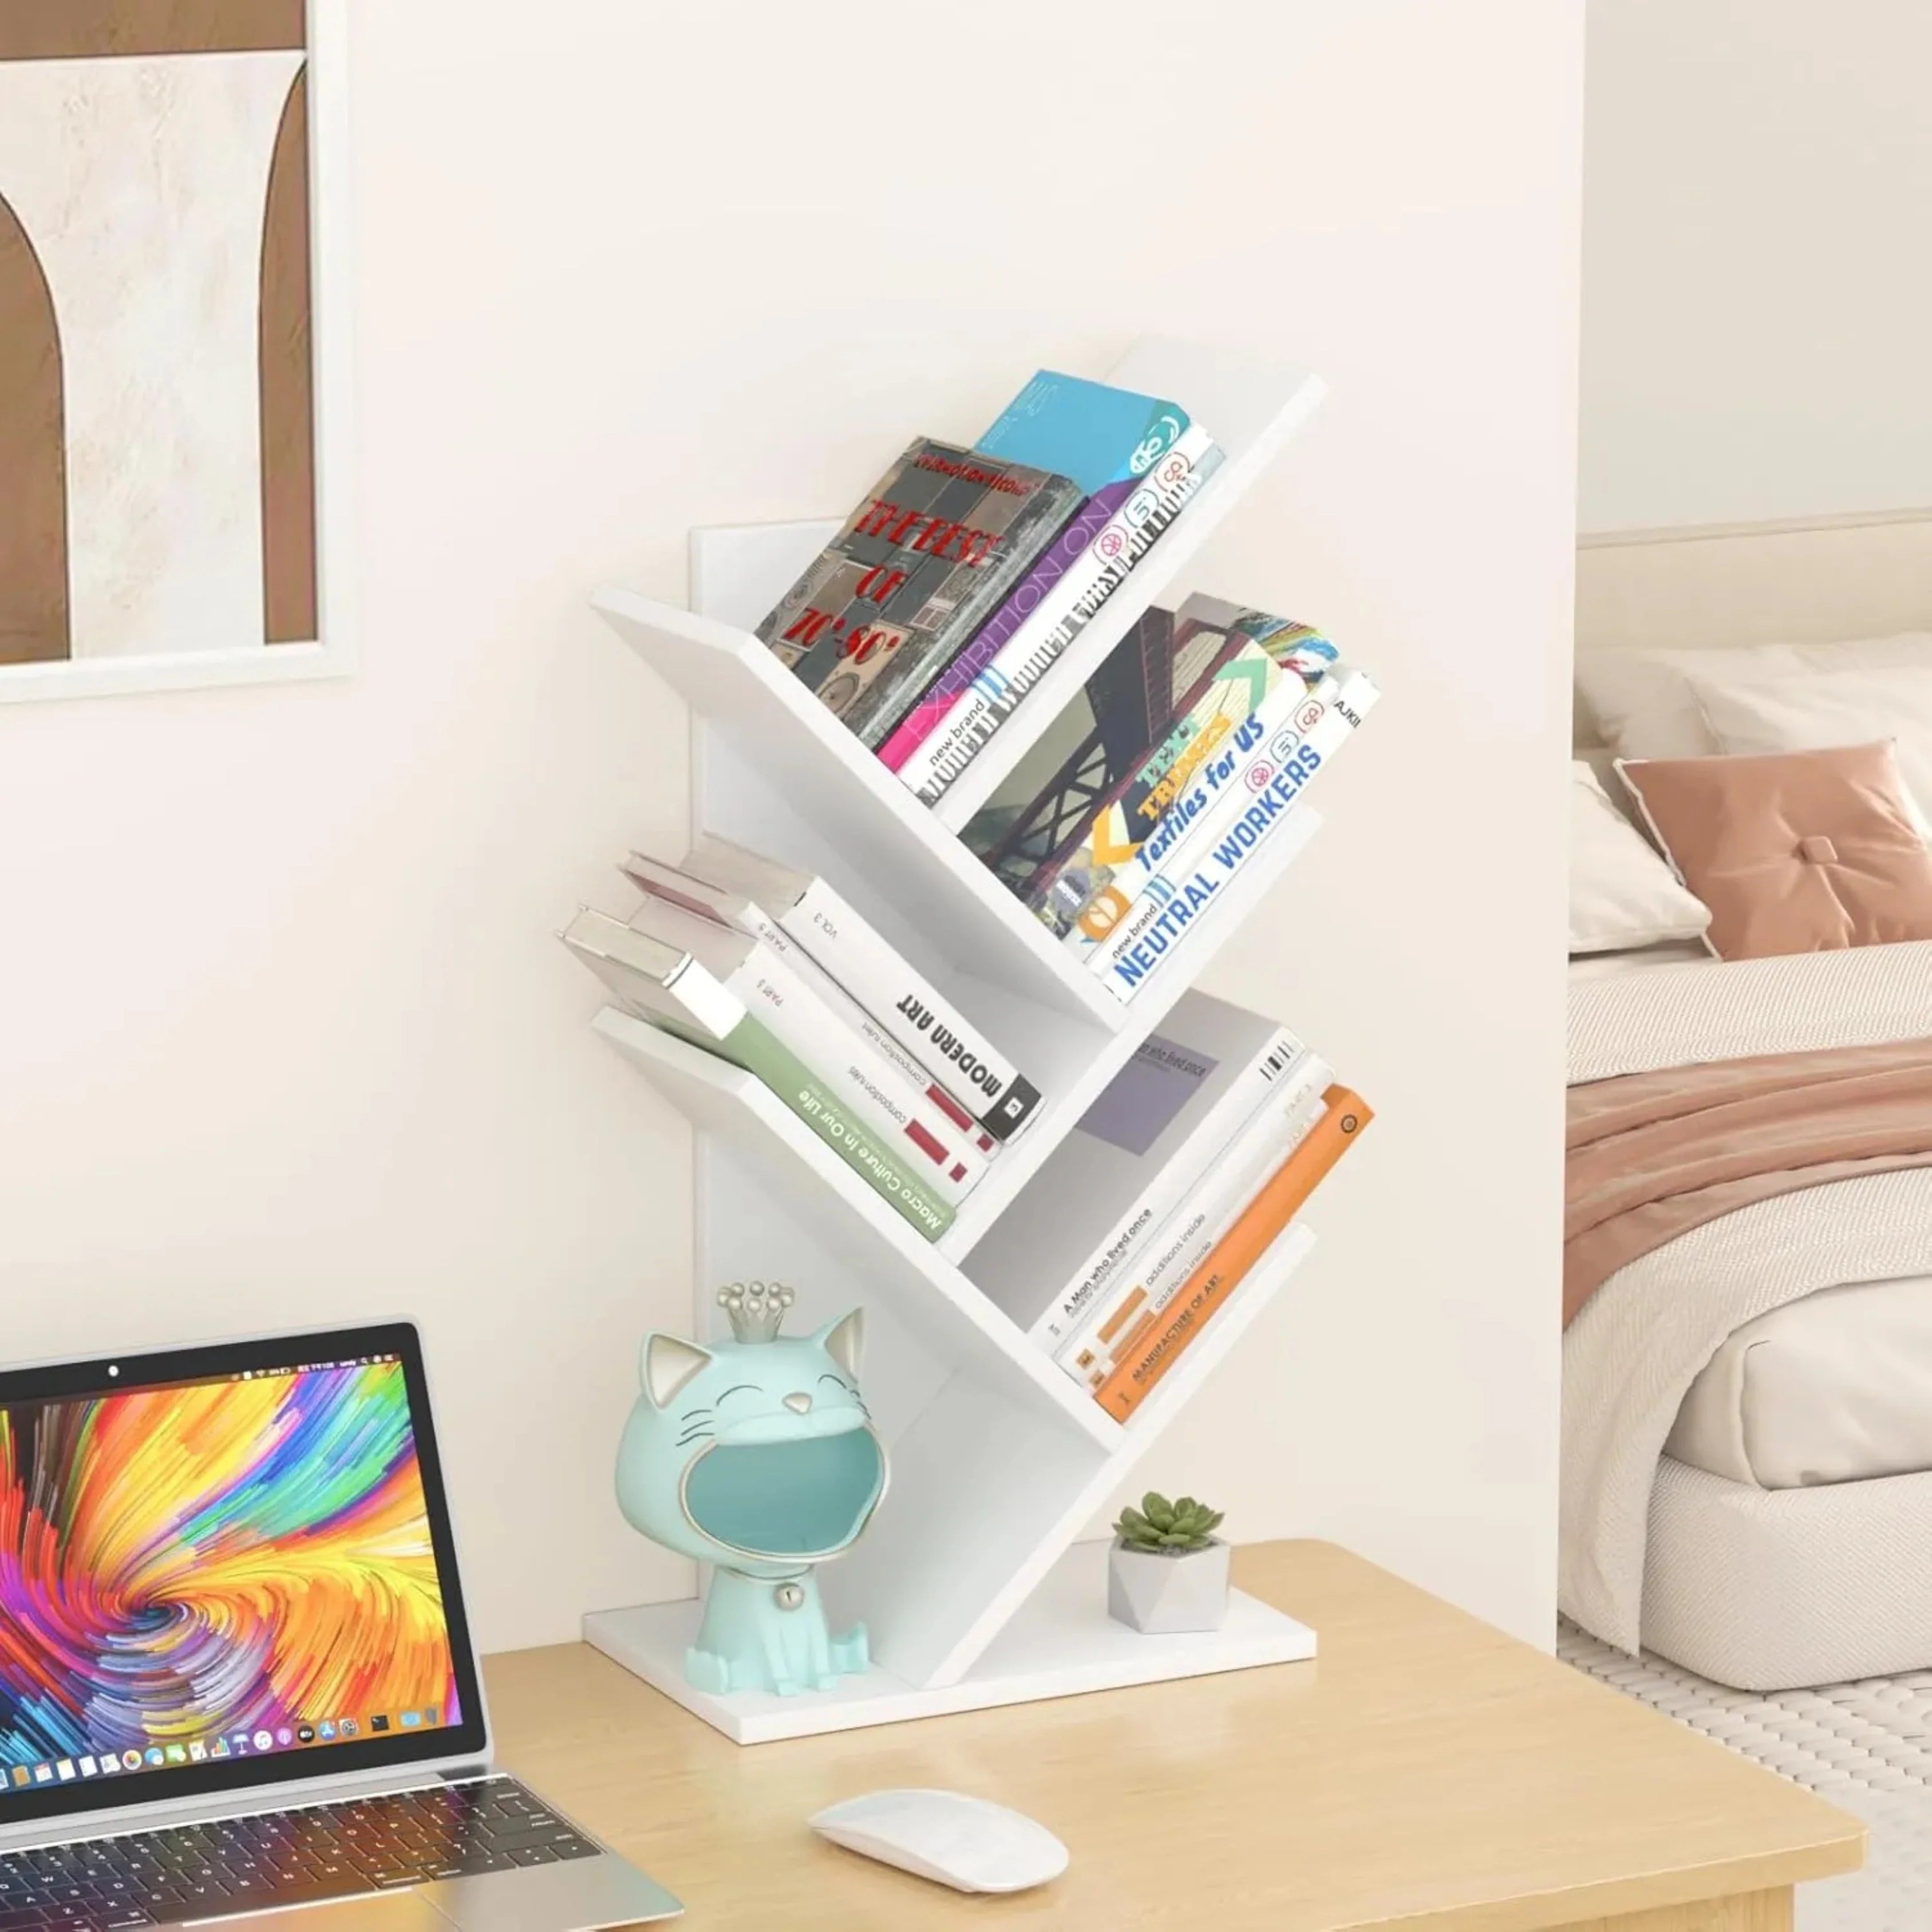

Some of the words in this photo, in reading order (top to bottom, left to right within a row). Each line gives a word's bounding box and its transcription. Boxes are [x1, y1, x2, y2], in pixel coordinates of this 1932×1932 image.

[903, 556, 1063, 742] EXHIBITION
[1063, 498, 1112, 551] ON
[929, 740, 955, 767] new
[950, 699, 985, 740] brand
[1135, 788, 1207, 871] Textiles
[1204, 750, 1236, 790] for
[1234, 712, 1265, 753] US
[1113, 873, 1220, 987] NEUTRAL
[1212, 744, 1322, 870] WORKERS
[1112, 934, 1132, 959] new
[1129, 904, 1158, 937] brand
[895, 994, 936, 1032] ART
[930, 1029, 1003, 1098] MODERN
[798, 1089, 823, 1115] Life
[818, 1109, 847, 1136] Our
[857, 1147, 902, 1194] Culture
[900, 1188, 943, 1231] Macro
[1063, 1303, 1072, 1314] A
[1070, 1281, 1092, 1305] Man
[1089, 1259, 1109, 1284] who
[1128, 1208, 1153, 1236] once
[1132, 1308, 1192, 1382] MANUFACTURE
[1191, 1294, 1204, 1309] OF
